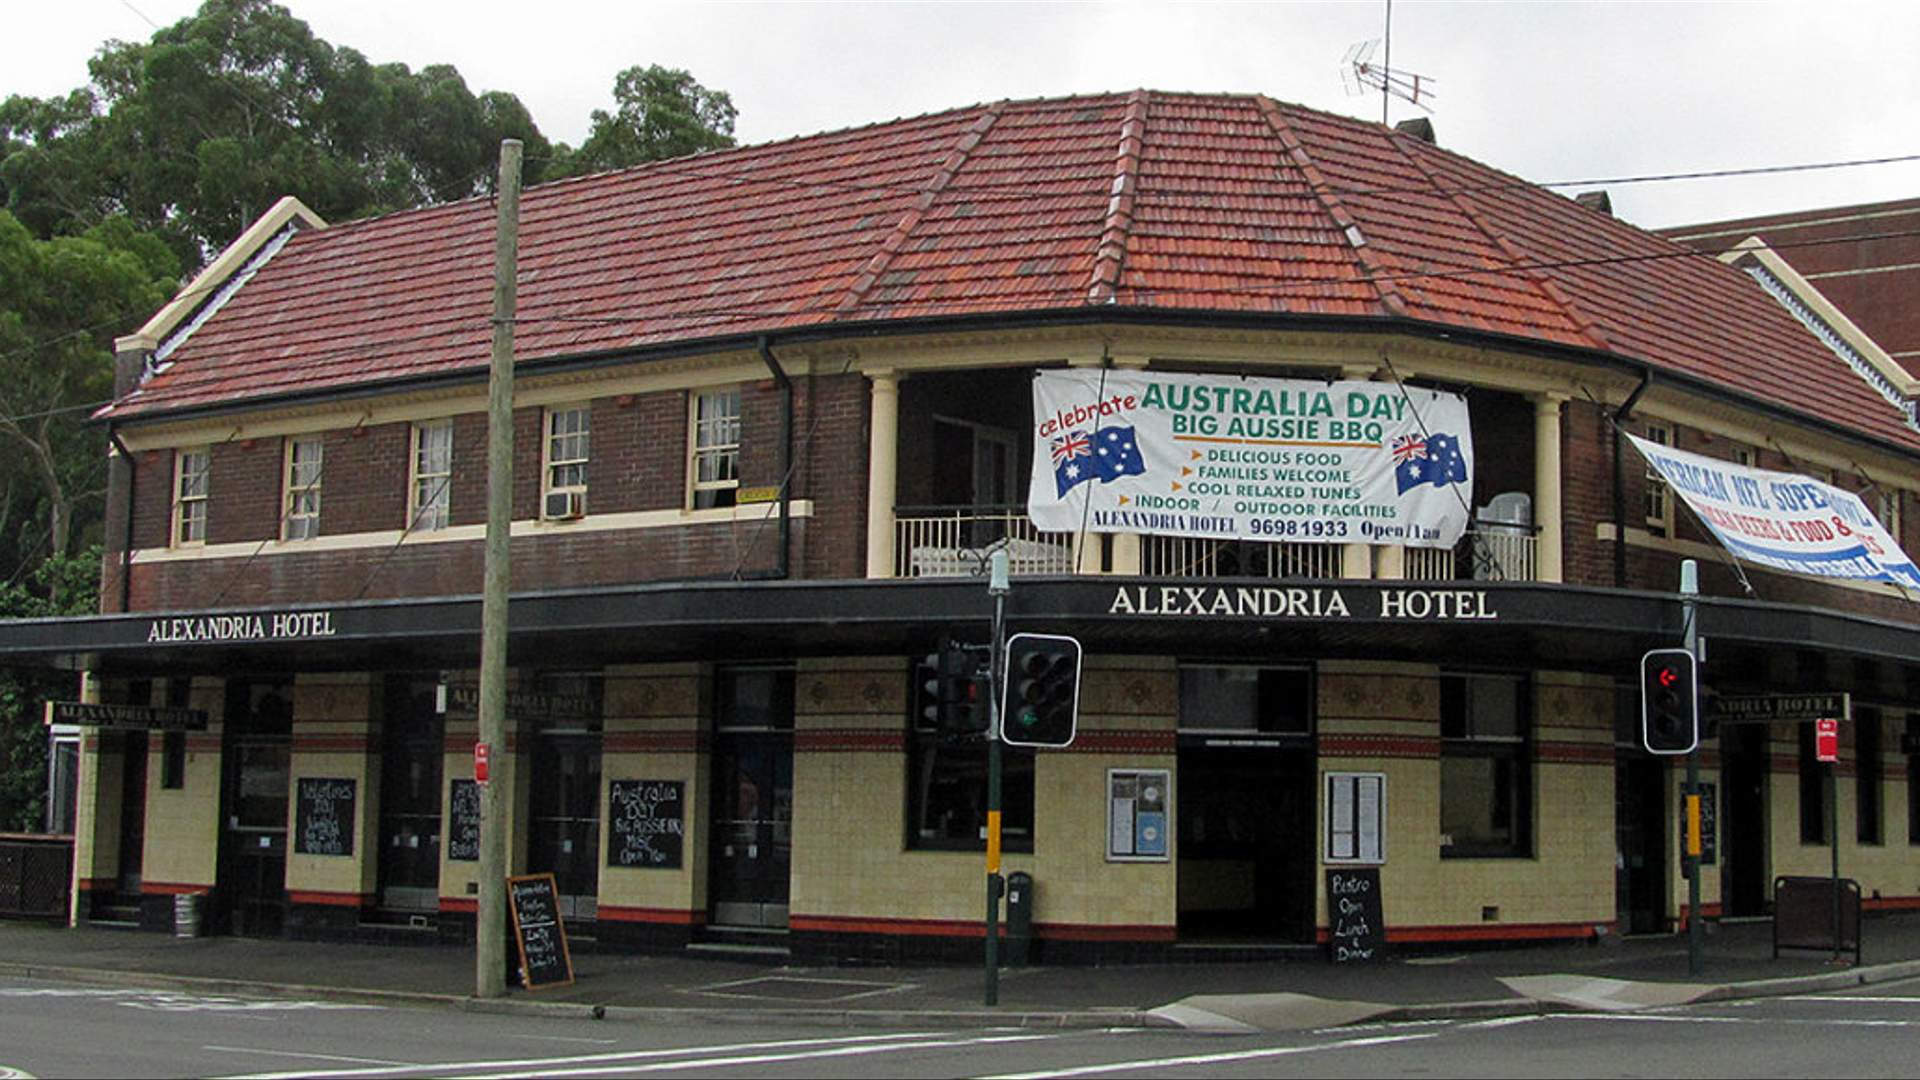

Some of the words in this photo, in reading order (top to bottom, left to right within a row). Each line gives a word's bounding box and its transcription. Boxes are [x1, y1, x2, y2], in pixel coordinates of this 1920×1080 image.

[1039, 394, 1137, 438] celebrate
[1141, 383, 1333, 418] AUSTRALIA
[1347, 391, 1408, 422] DAY
[1172, 413, 1219, 436] BIG
[1227, 416, 1319, 440] AUSSIE
[1328, 420, 1383, 444] BBQ
[1207, 449, 1291, 466] DELICIOUS
[1295, 453, 1342, 466] FOOD
[1199, 465, 1268, 481] FAMILIES
[1272, 468, 1351, 484] WELCOME
[1188, 481, 1231, 496] COOL
[1236, 484, 1305, 499] RELAXED
[1311, 486, 1362, 500] TUNES
[1730, 474, 1771, 511] NFL
[1135, 494, 1200, 511] INDOOR
[1233, 500, 1315, 516] OUTDOOR
[1322, 503, 1397, 519] FACILITIES
[1092, 510, 1185, 531] ALEXANDRIA
[1189, 515, 1237, 533] HOTEL
[1360, 520, 1403, 540] Open
[1788, 519, 1835, 542] FOOD
[1831, 516, 1852, 537] &
[1109, 586, 1350, 617] ALEXANDRIA
[1380, 590, 1498, 618] HOTEL
[147, 615, 265, 643] ALEXANDRIA
[271, 612, 337, 638] HOTEL
[1332, 874, 1371, 895] Bistro
